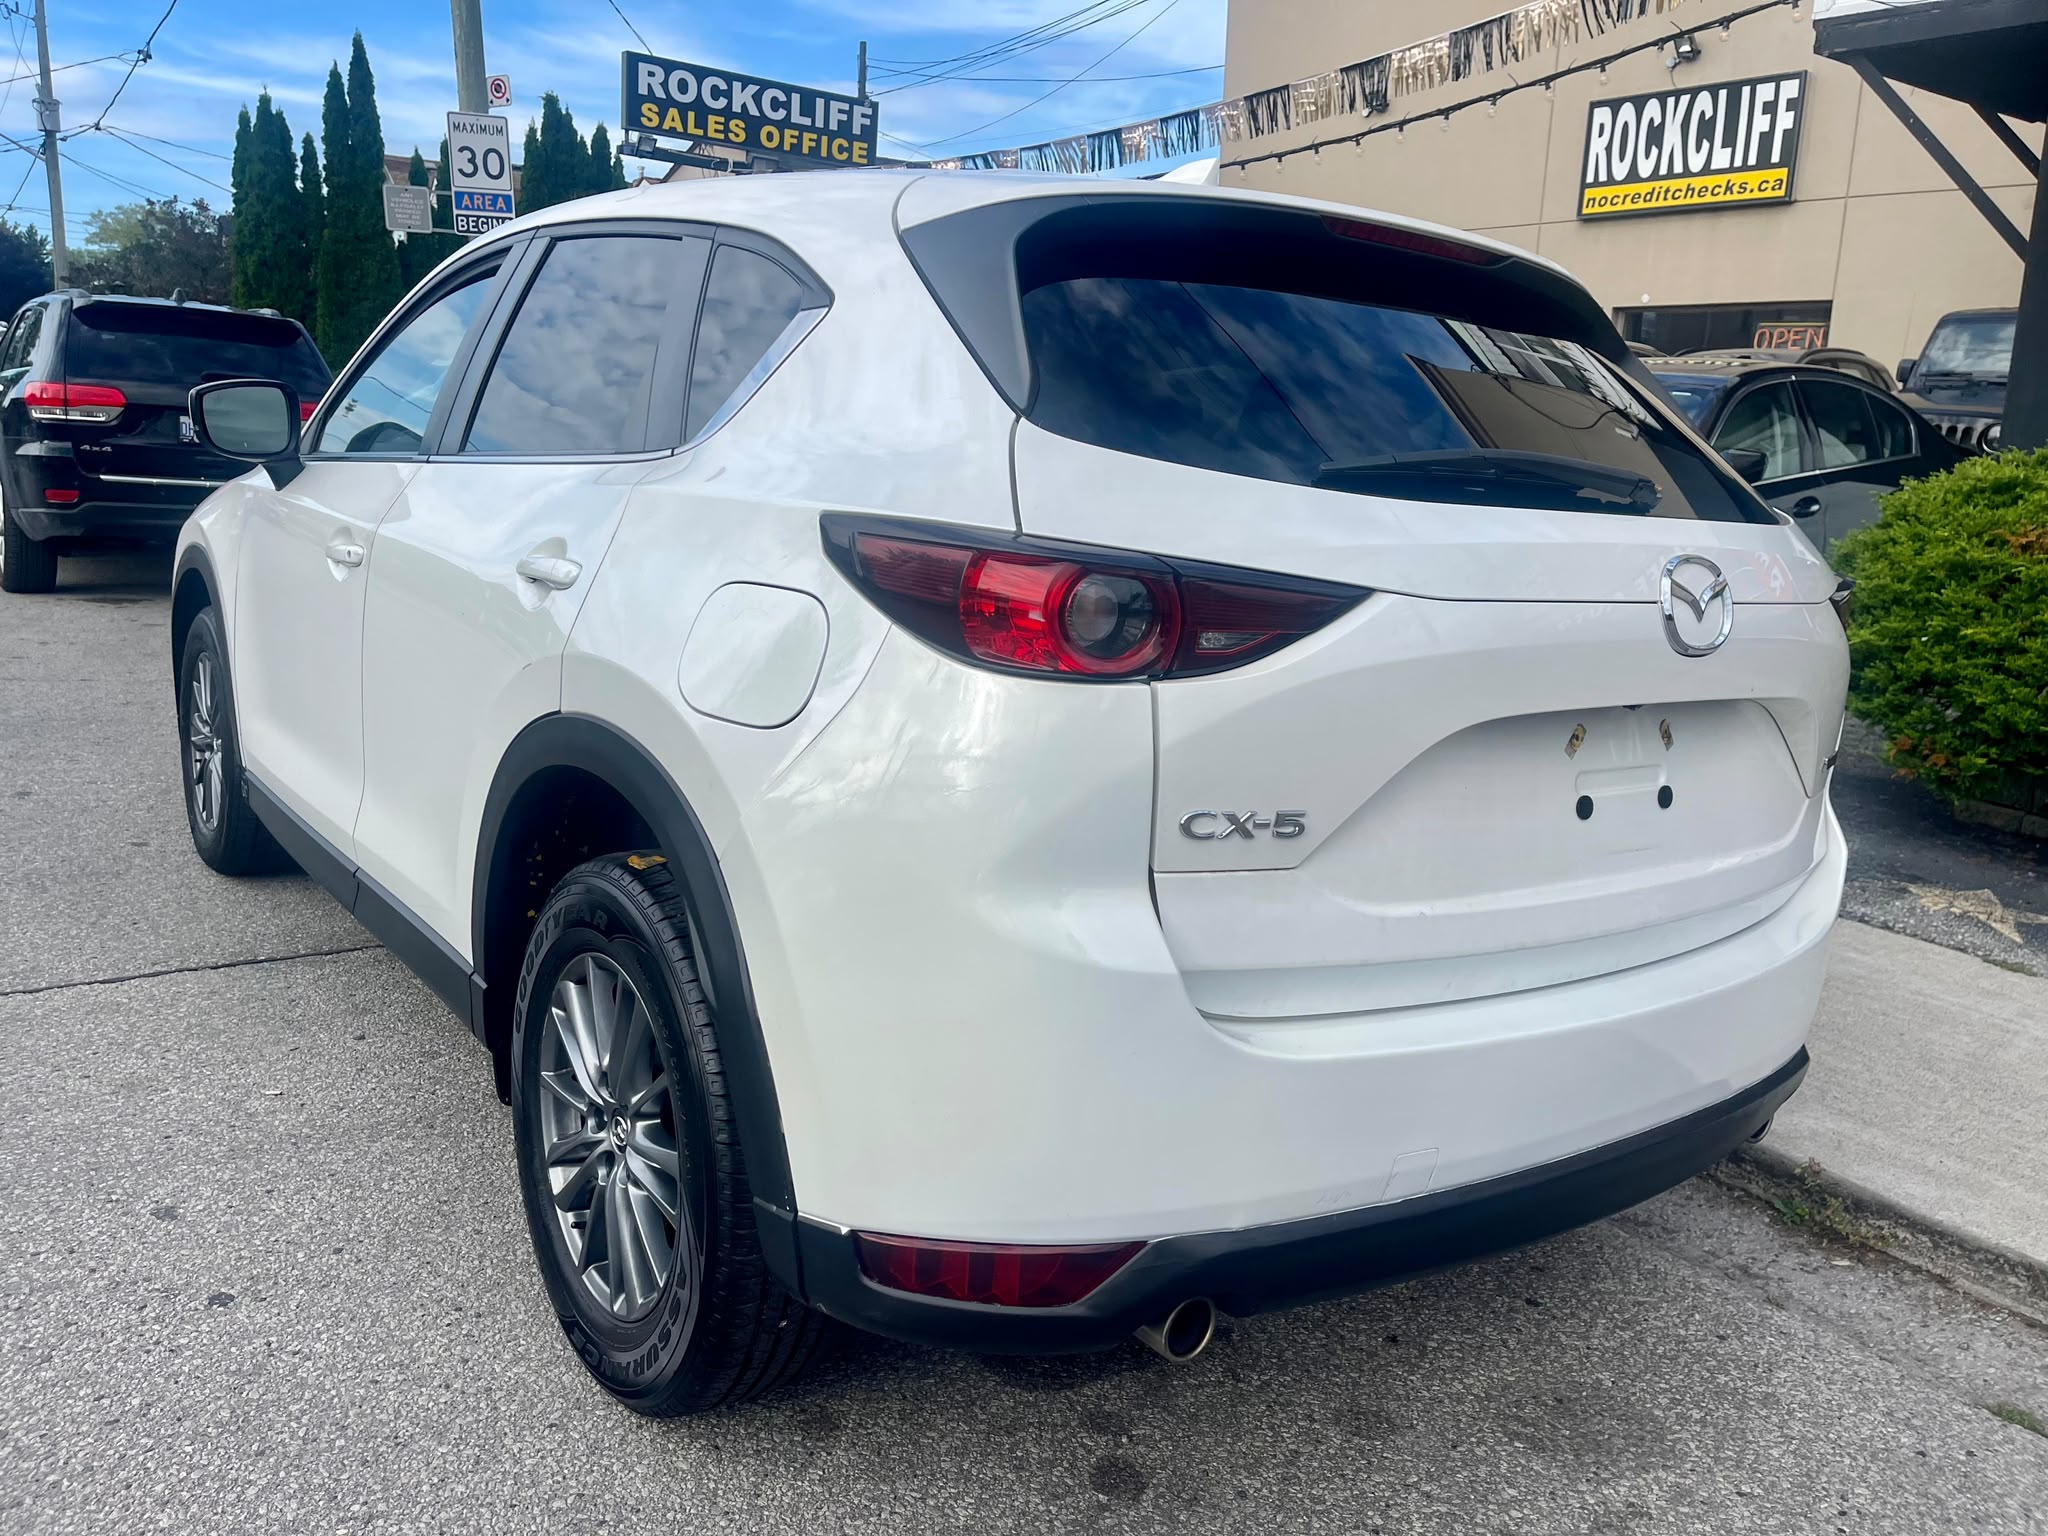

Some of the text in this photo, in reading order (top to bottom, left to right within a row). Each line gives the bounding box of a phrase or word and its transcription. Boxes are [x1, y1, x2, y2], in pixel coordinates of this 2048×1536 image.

[637, 61, 873, 135] ROCKCLIFF
[452, 121, 504, 137] MAXIMUM
[640, 102, 869, 164] SALES OFFICE
[1585, 78, 1800, 184] ROCKCLIFF
[457, 145, 505, 180] 30
[461, 194, 507, 211] AREA
[1585, 176, 1784, 209] nocreditchecks.ca
[1753, 327, 1825, 351] OPEN
[1178, 809, 1307, 840] CX-5
